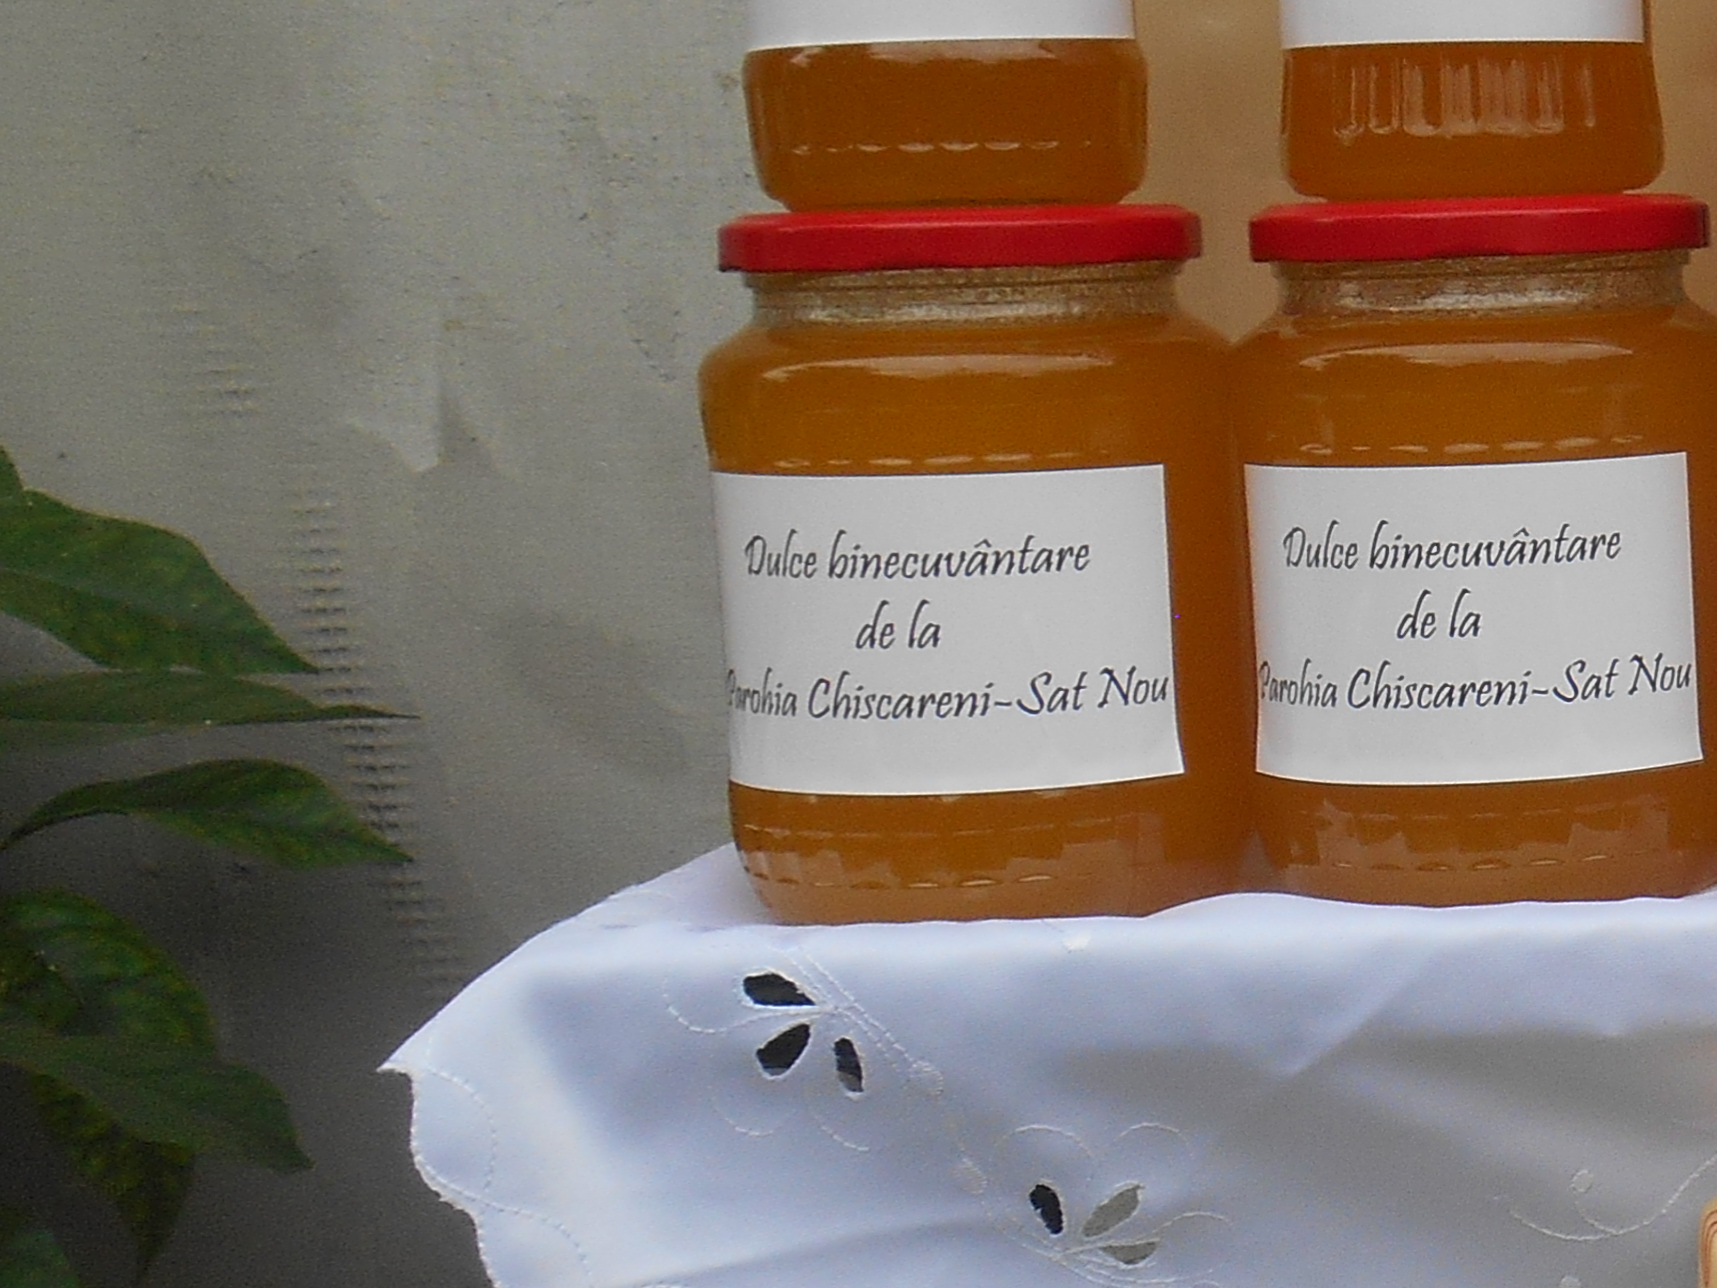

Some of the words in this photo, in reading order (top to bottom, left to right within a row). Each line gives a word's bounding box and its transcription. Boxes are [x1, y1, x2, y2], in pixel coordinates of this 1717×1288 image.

[745, 529, 817, 579] Dulce
[828, 530, 1090, 579] binecuvântare
[1283, 520, 1359, 569] Dulce
[1369, 520, 1622, 569] binecuvântare
[855, 600, 895, 649] de
[907, 600, 940, 648] la
[1396, 589, 1436, 639] de
[1449, 588, 1481, 638] la
[808, 670, 1087, 720] Chiscareni-Sat
[1097, 666, 1169, 708] Nou
[1259, 658, 1337, 708] Parohia
[1347, 660, 1619, 710] Chiscareni-Sat
[1628, 652, 1692, 695] Nou
